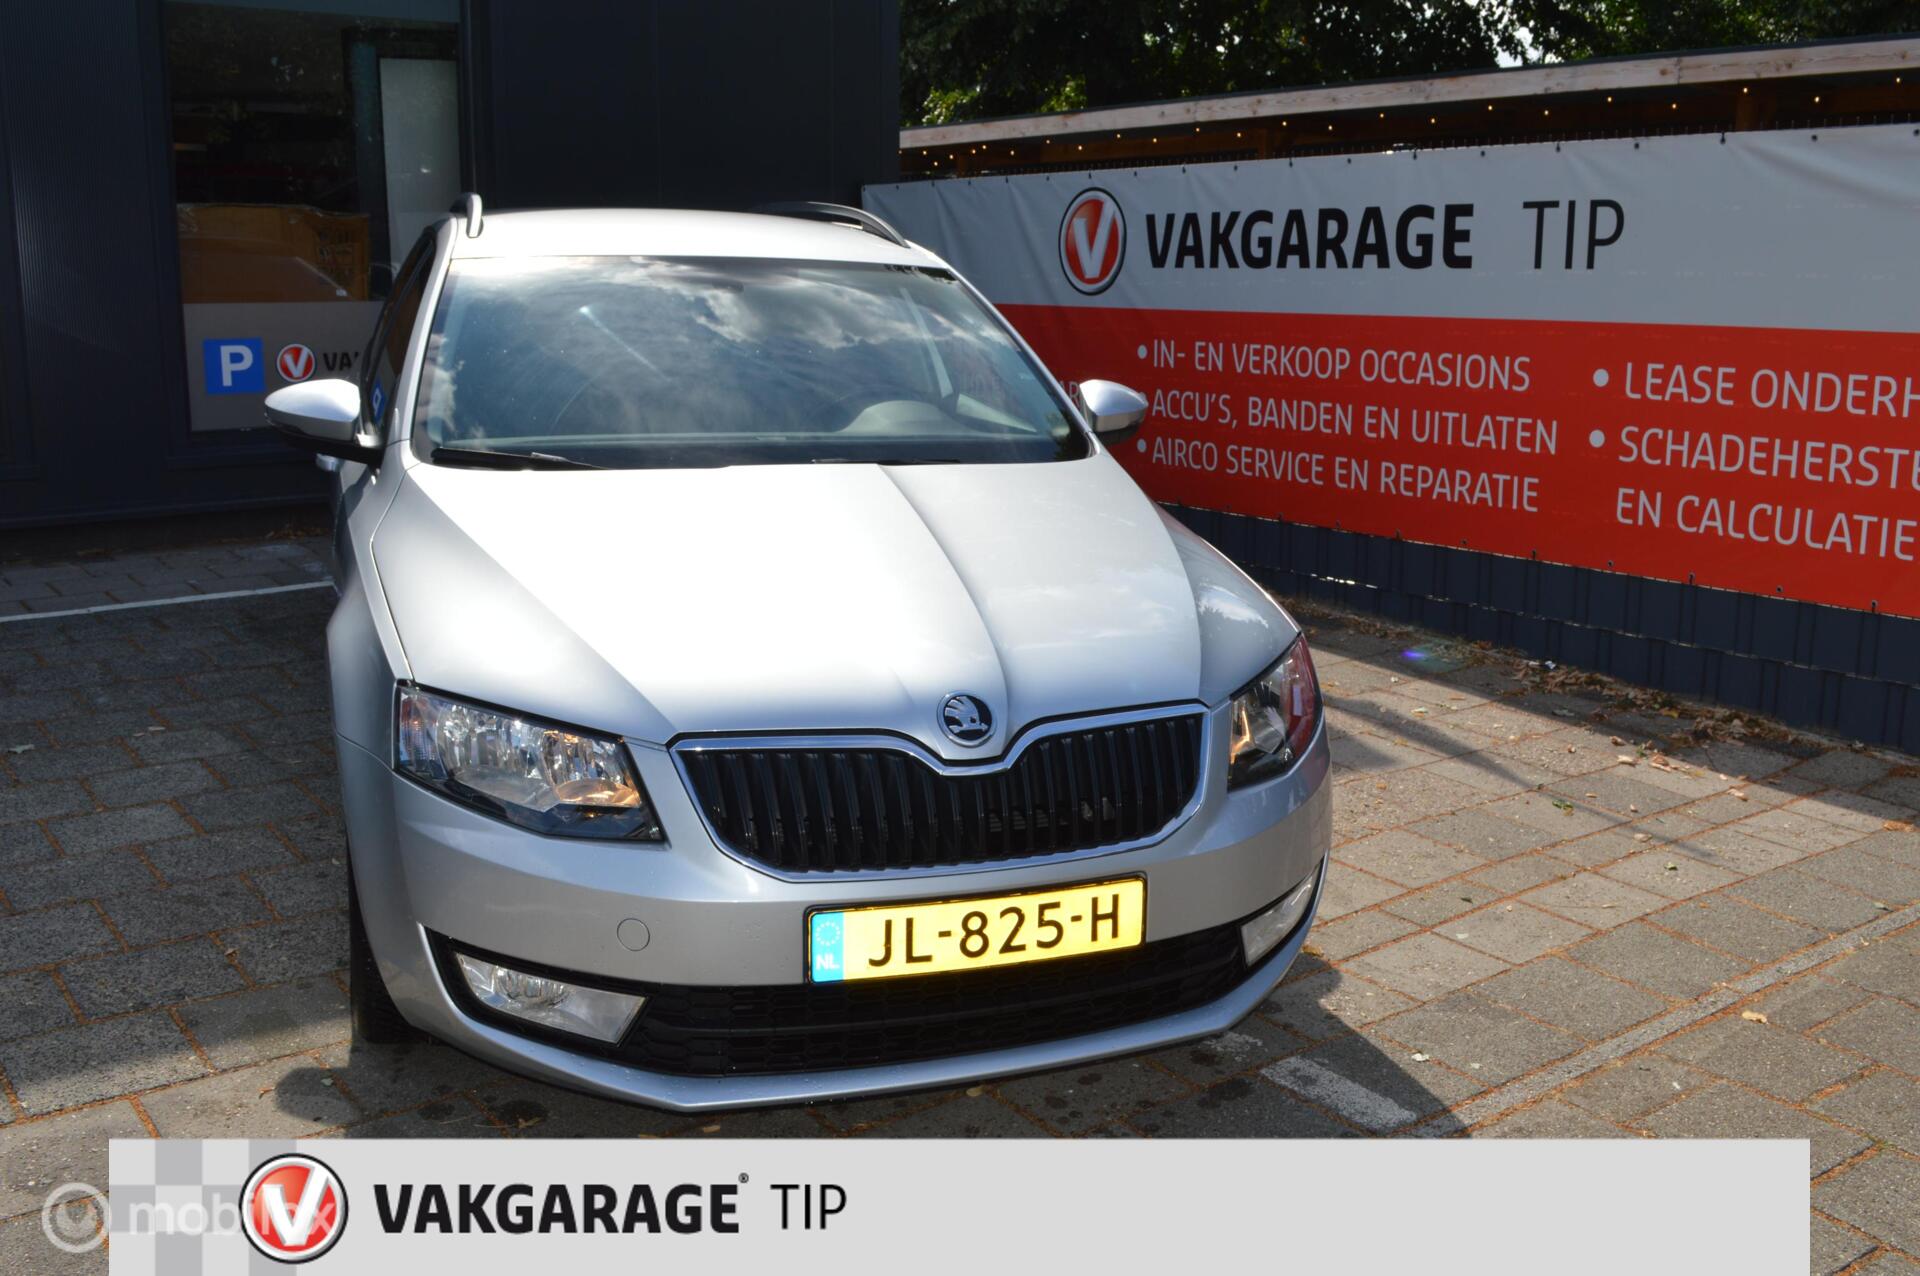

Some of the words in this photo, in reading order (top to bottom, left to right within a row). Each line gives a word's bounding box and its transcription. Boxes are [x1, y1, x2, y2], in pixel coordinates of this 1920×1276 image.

[1145, 203, 1474, 270] VAKGARAGE
[1522, 199, 1625, 270] TIP
[220, 345, 253, 387] P
[323, 352, 359, 372] VA
[1153, 339, 1186, 368] IN-
[1195, 341, 1223, 372] EN
[1232, 343, 1350, 380] VERKOOP
[1360, 349, 1531, 391] OCCASIONS
[1624, 362, 1736, 406] LEASE
[1751, 369, 1920, 418] ONDERH
[1152, 388, 1237, 429] ACCU'S,
[1248, 396, 1352, 435] BANDEN
[1364, 405, 1399, 440] EN
[1412, 409, 1557, 455] UITLATEN
[1152, 436, 1218, 471] AIRCO
[1226, 444, 1324, 485] SERVICE
[1335, 456, 1368, 491] EN
[1380, 461, 1539, 512] REPARATIE
[1616, 488, 1662, 528] EN
[1676, 495, 1918, 561] CALCULATIE
[868, 893, 1119, 968] JL-825-H
[816, 953, 840, 971] NL
